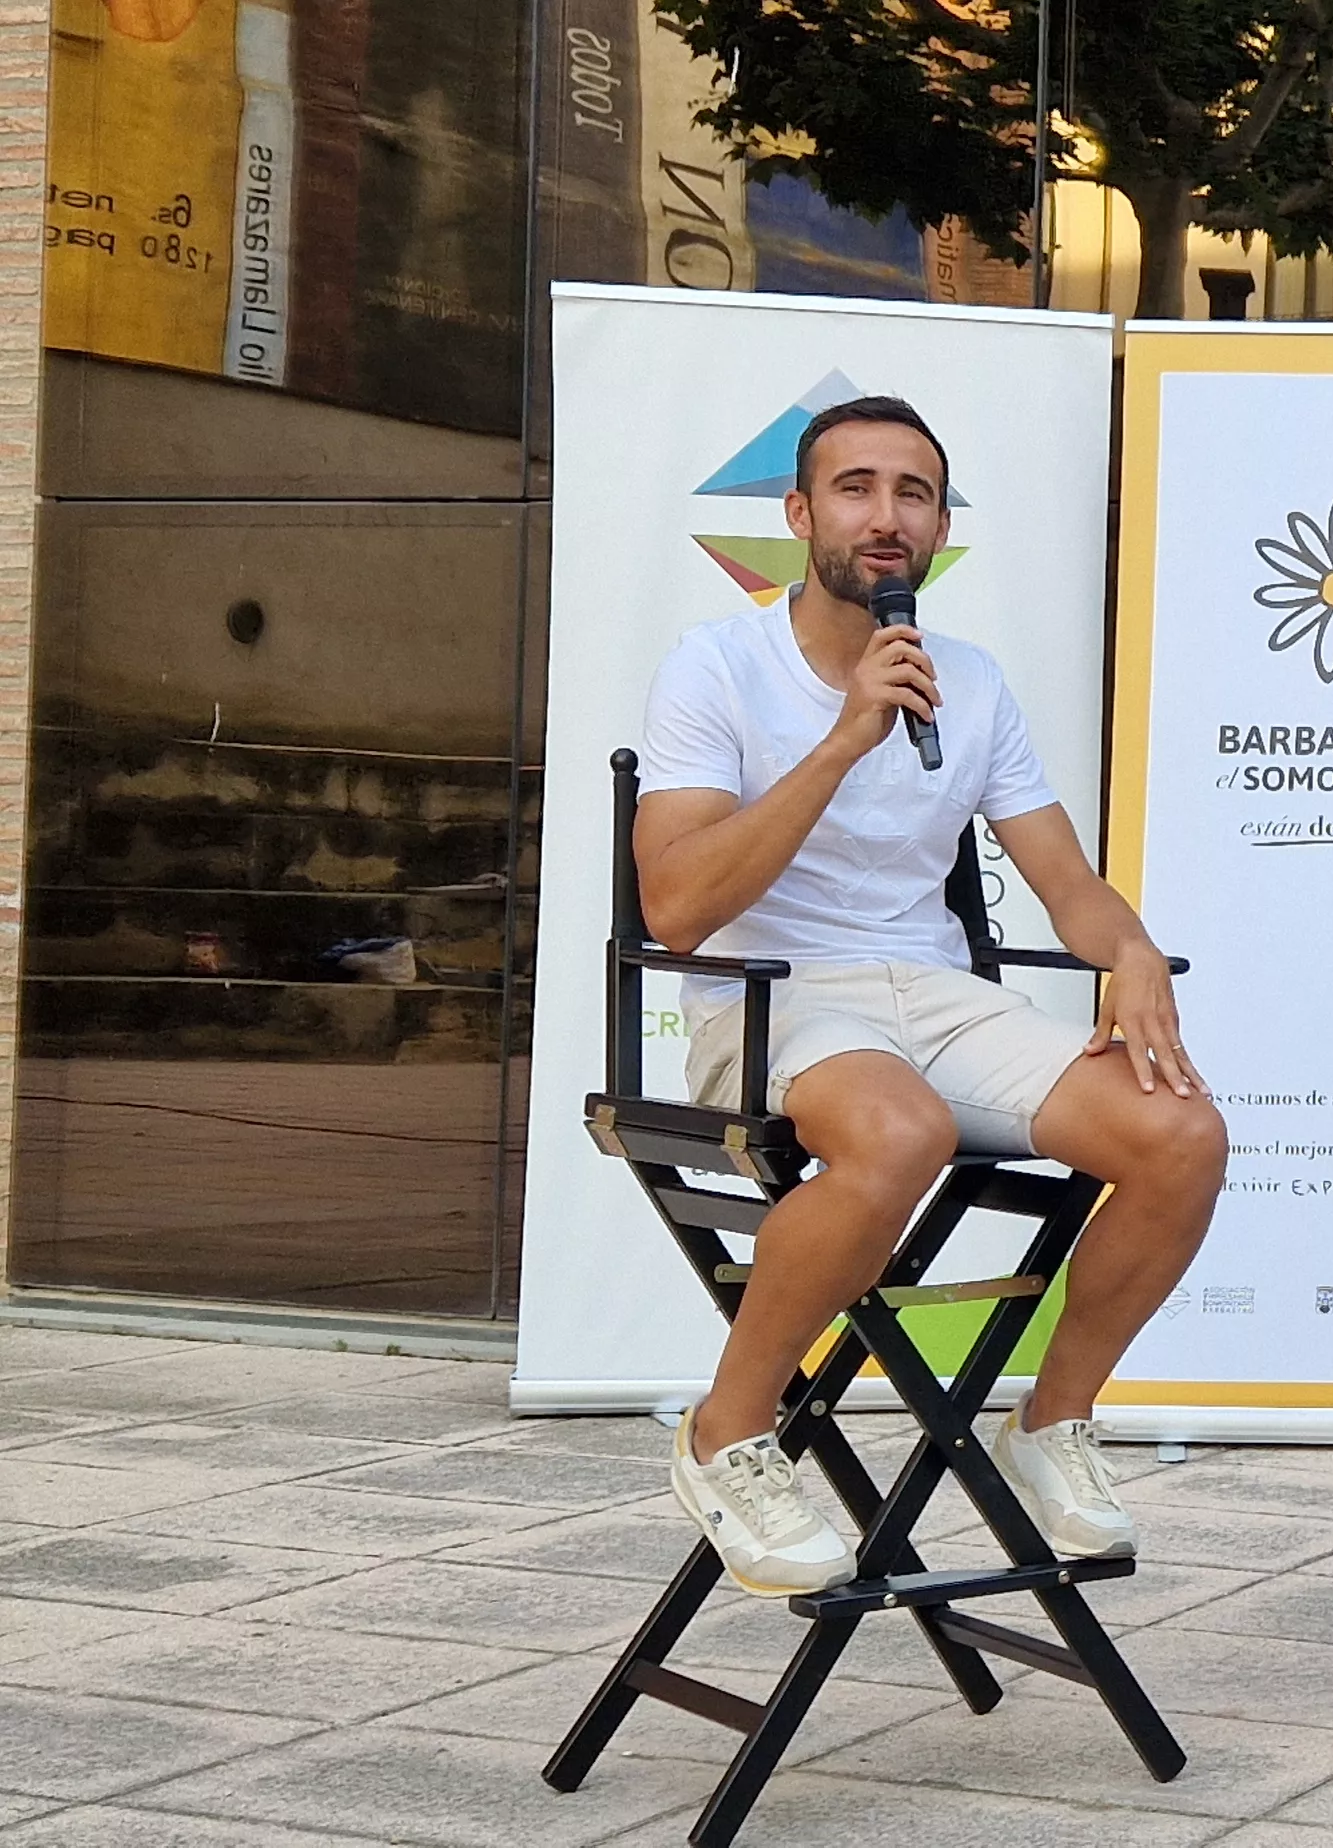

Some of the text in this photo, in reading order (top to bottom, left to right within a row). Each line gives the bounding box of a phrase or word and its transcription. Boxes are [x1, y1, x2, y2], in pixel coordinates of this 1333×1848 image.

[1215, 766, 1240, 790] el
[1239, 815, 1302, 837] están
[1227, 1092, 1302, 1106] estamos
[1305, 1089, 1328, 1106] de
[1264, 1139, 1280, 1156] el
[1241, 1176, 1282, 1193] vivir
